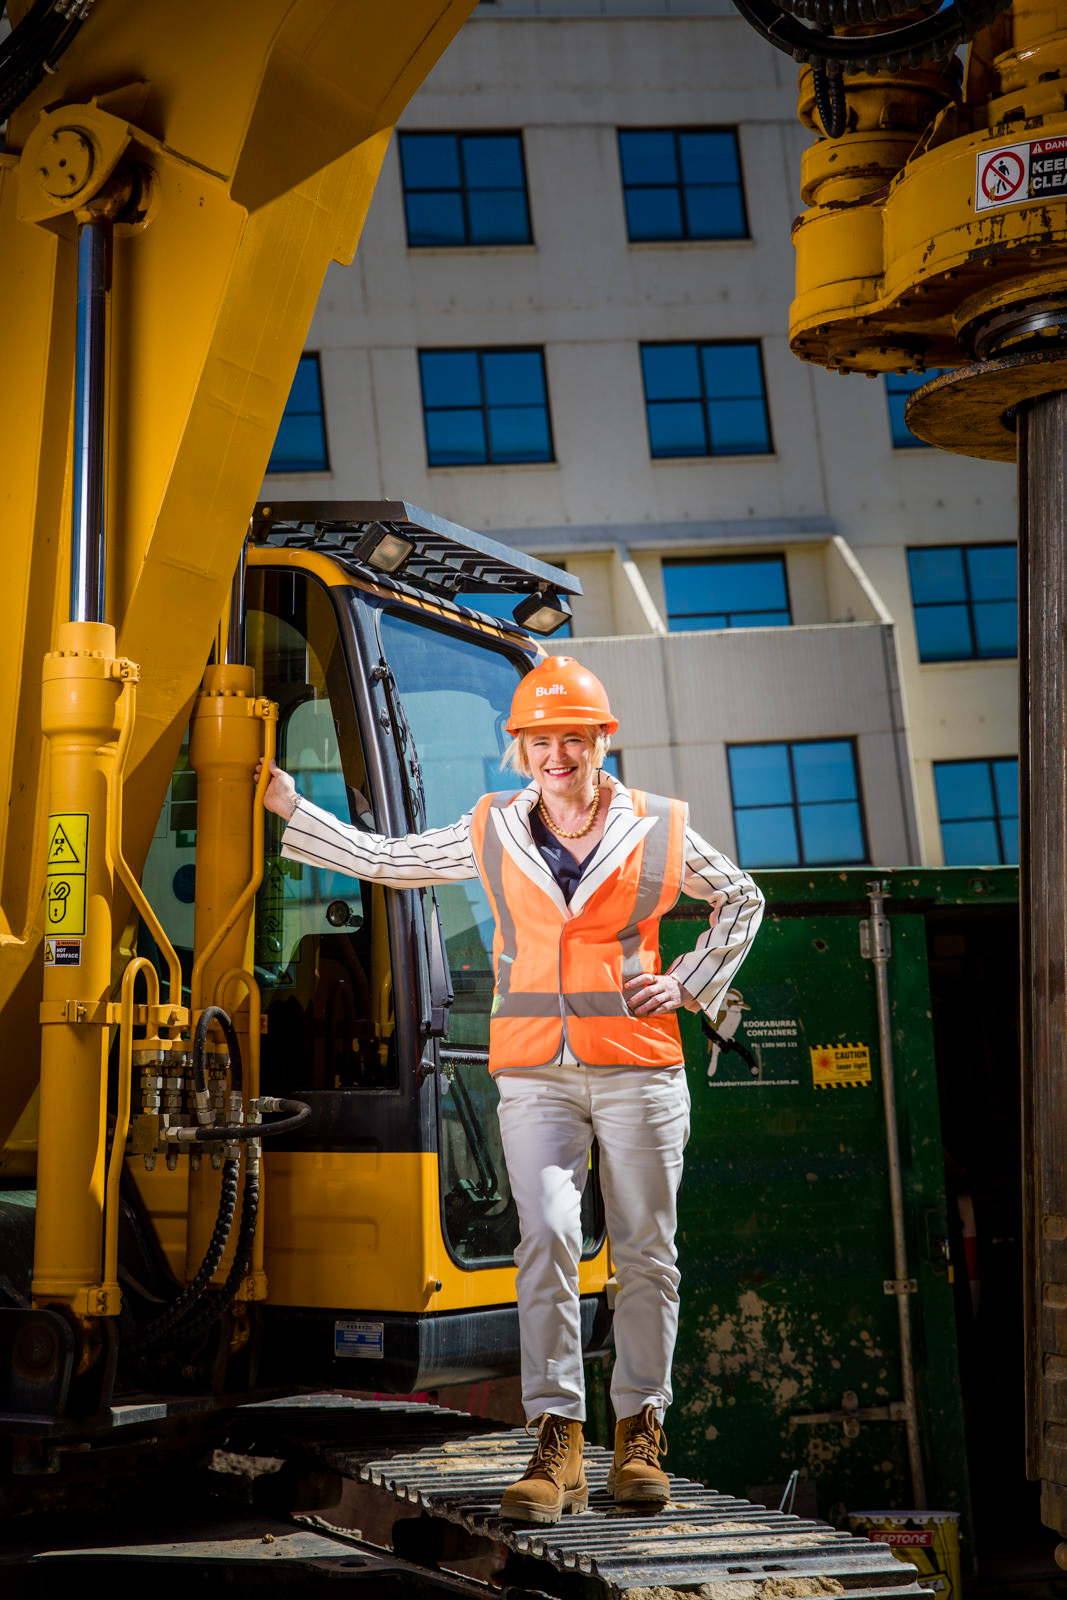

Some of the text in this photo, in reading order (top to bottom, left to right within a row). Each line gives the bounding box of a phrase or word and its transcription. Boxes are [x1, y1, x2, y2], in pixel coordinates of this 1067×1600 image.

[535, 684, 568, 698] Built.
[743, 1020, 797, 1028] KOOKABURRA
[746, 1028, 798, 1037] CONTAINERS
[834, 1050, 867, 1060] CAUTION
[853, 1062, 868, 1070] light
[873, 1533, 929, 1544] SEPTONE
